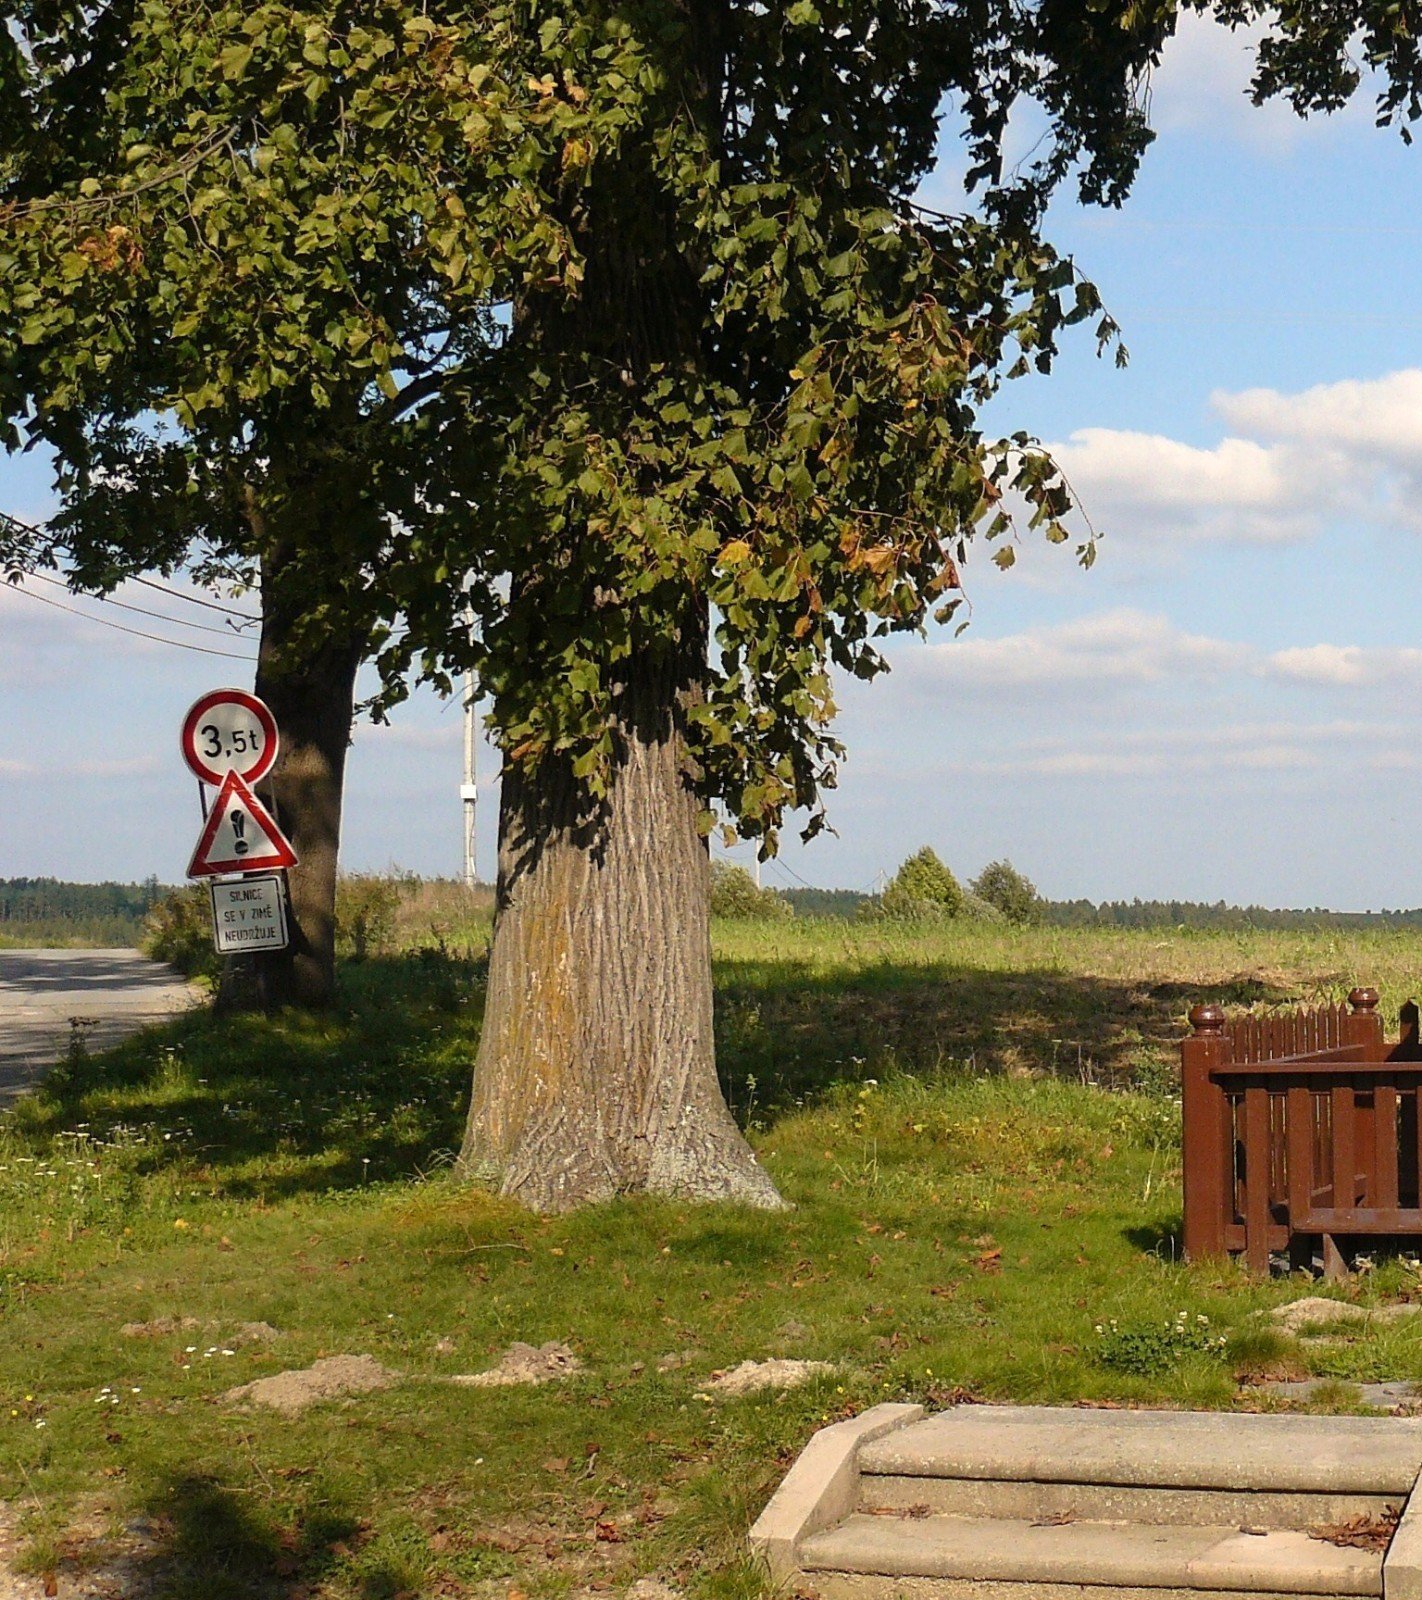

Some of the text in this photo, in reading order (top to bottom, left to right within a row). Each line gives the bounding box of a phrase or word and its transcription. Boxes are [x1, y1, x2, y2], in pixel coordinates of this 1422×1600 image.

[201, 724, 259, 758] 3,5t
[229, 888, 263, 902] SILNICE
[224, 910, 236, 923] SE
[239, 909, 246, 921] V
[225, 925, 276, 942] NEUDRŽUJE
